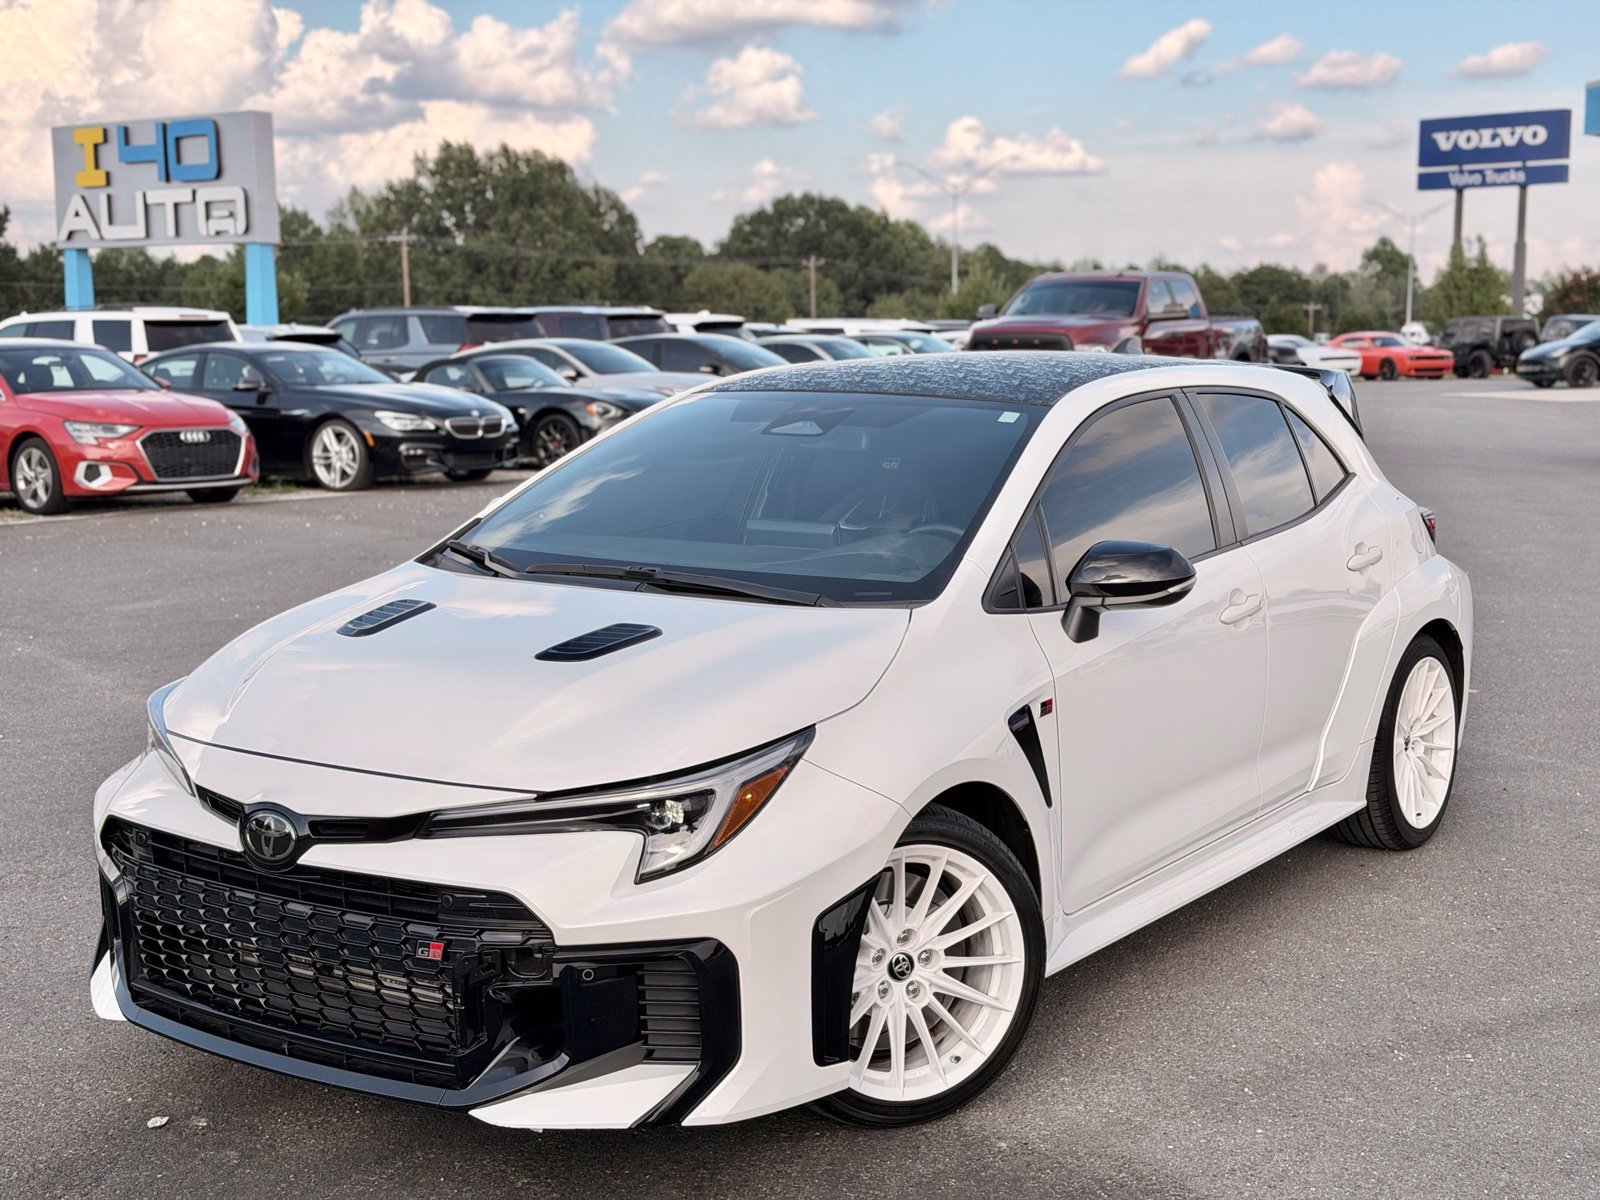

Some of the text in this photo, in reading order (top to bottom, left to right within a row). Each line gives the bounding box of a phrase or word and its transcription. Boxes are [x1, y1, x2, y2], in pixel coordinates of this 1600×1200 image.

[1432, 124, 1548, 152] VOLVO
[1448, 169, 1526, 187] Volvo Trucks
